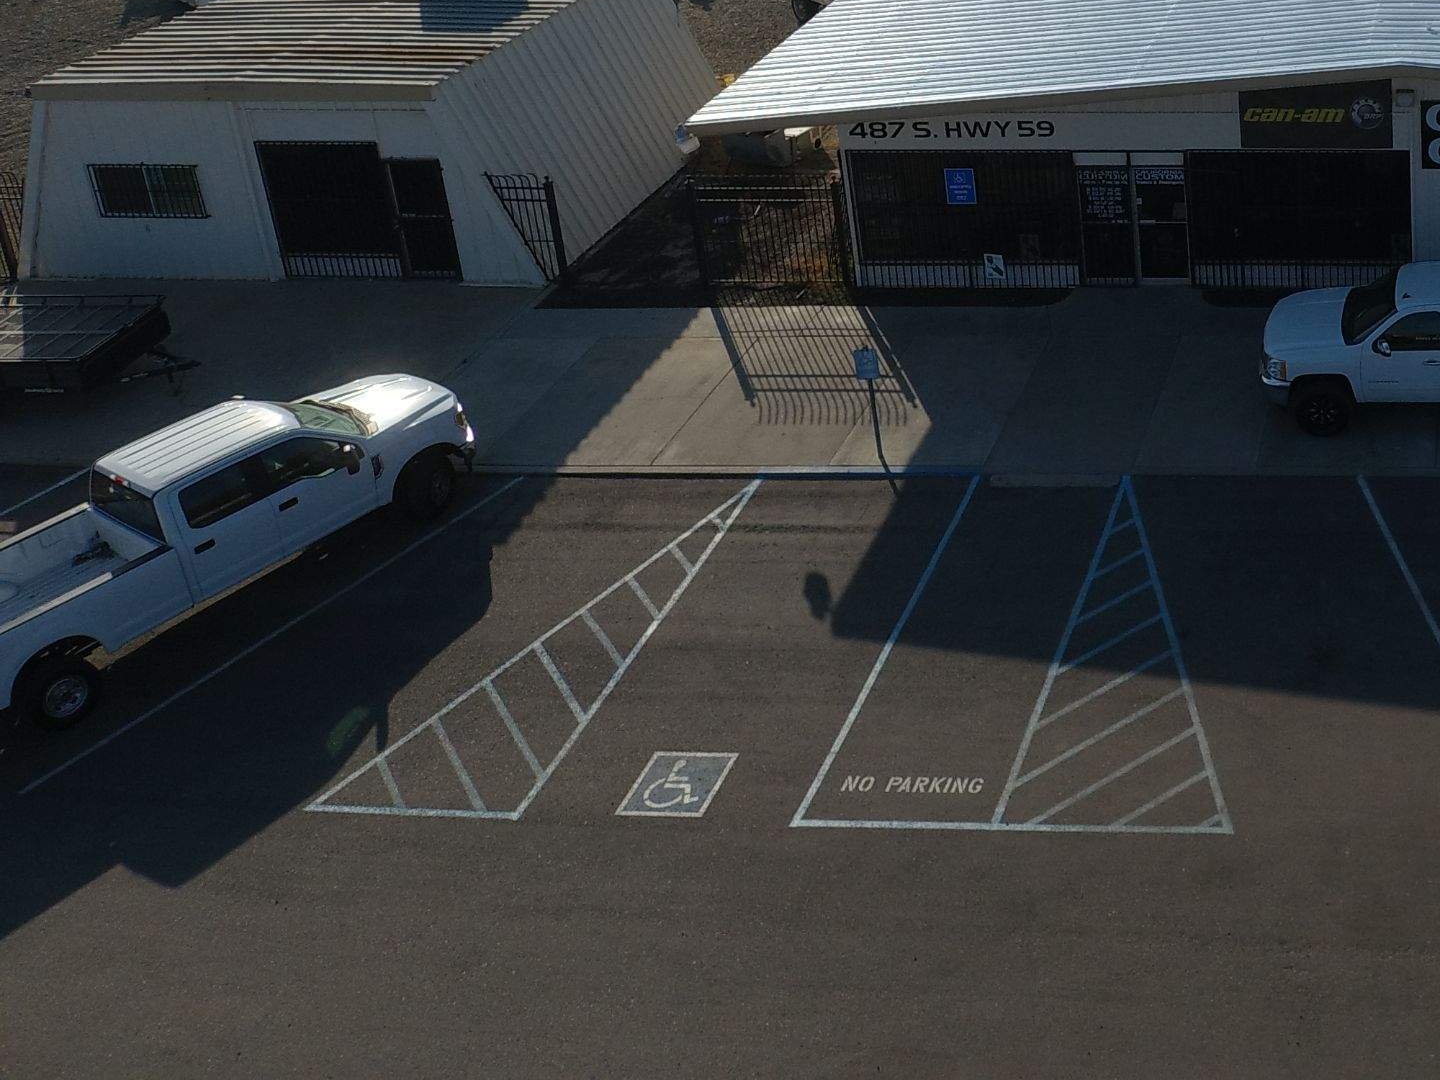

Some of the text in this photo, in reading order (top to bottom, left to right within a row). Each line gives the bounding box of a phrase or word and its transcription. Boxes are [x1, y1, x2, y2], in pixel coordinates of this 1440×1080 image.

[1243, 107, 1345, 123] can-am
[848, 120, 1055, 139] 487 S. HWY 59
[840, 775, 985, 794] NO PARKING
